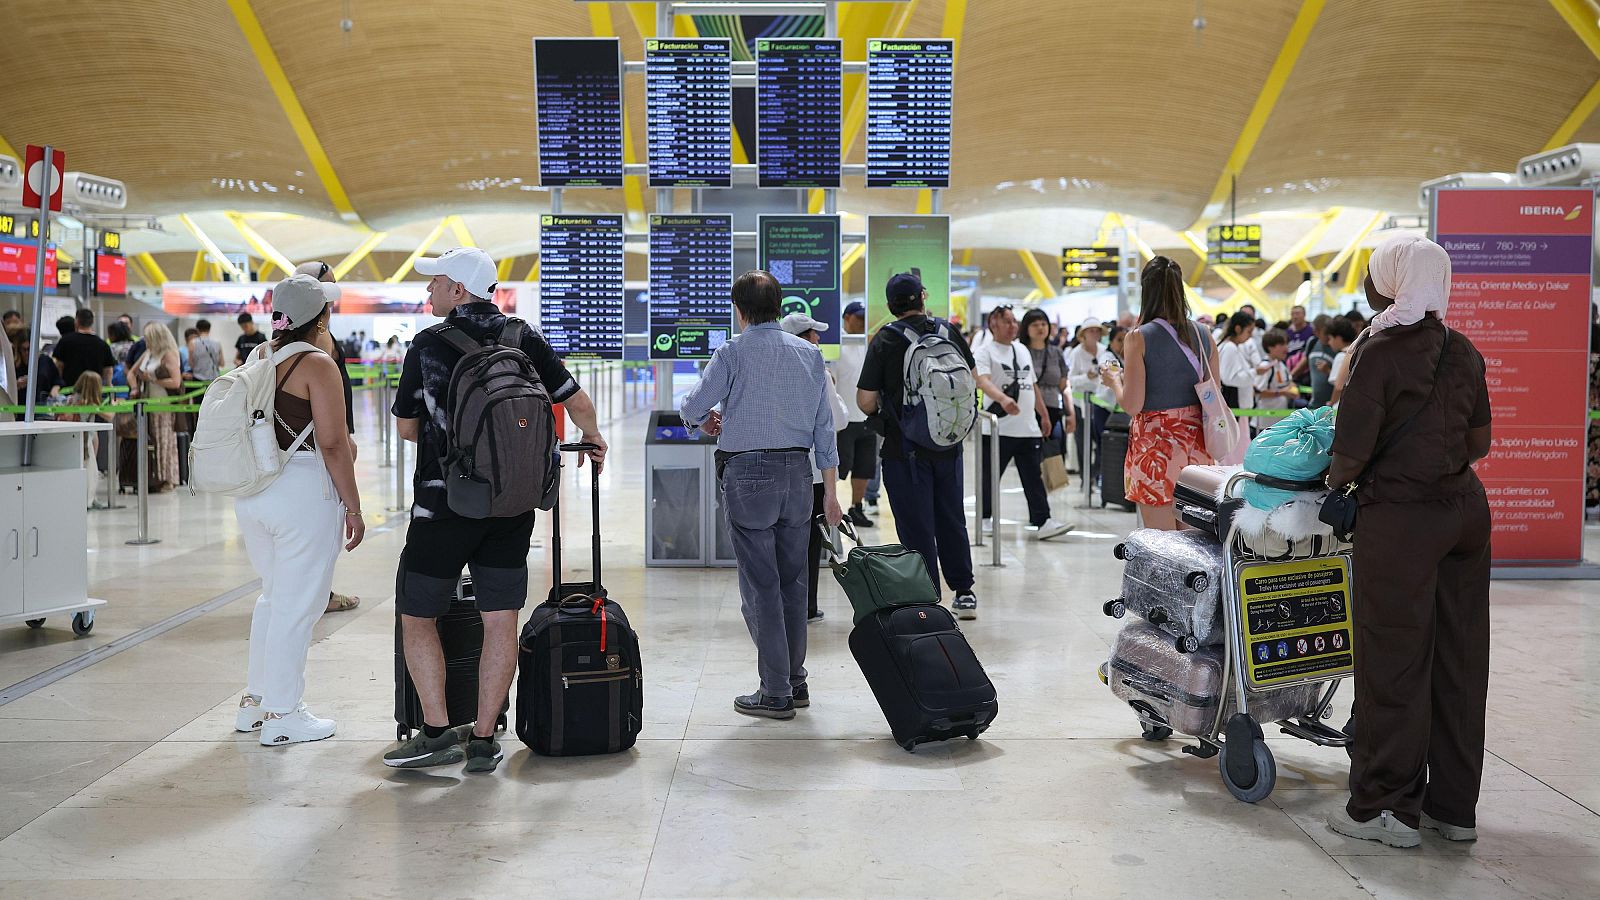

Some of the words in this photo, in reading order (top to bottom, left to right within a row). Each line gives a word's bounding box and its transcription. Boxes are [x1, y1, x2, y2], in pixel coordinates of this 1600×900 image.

[1520, 206, 1564, 215] IBERIA
[1444, 241, 1480, 250] Business
[1496, 242, 1513, 250] 780
[1520, 242, 1536, 250] 799
[1450, 281, 1478, 291] mérica,
[1481, 281, 1511, 290] Oriente
[1539, 283, 1545, 292] y
[1546, 282, 1569, 291] Dakar
[1448, 301, 1476, 310] merica,
[1478, 301, 1505, 310] Middle
[1505, 301, 1522, 310] East
[1524, 302, 1532, 310] &
[1533, 301, 1556, 310] Dakar
[1466, 320, 1483, 329] 829
[1485, 357, 1502, 367] frica
[1500, 438, 1523, 448] Japón
[1531, 438, 1554, 447] Reino
[1555, 438, 1578, 447] Unido
[1505, 451, 1531, 459] United
[1531, 451, 1568, 461] Kingdom
[1503, 487, 1532, 495] clientes
[1493, 512, 1504, 521] for
